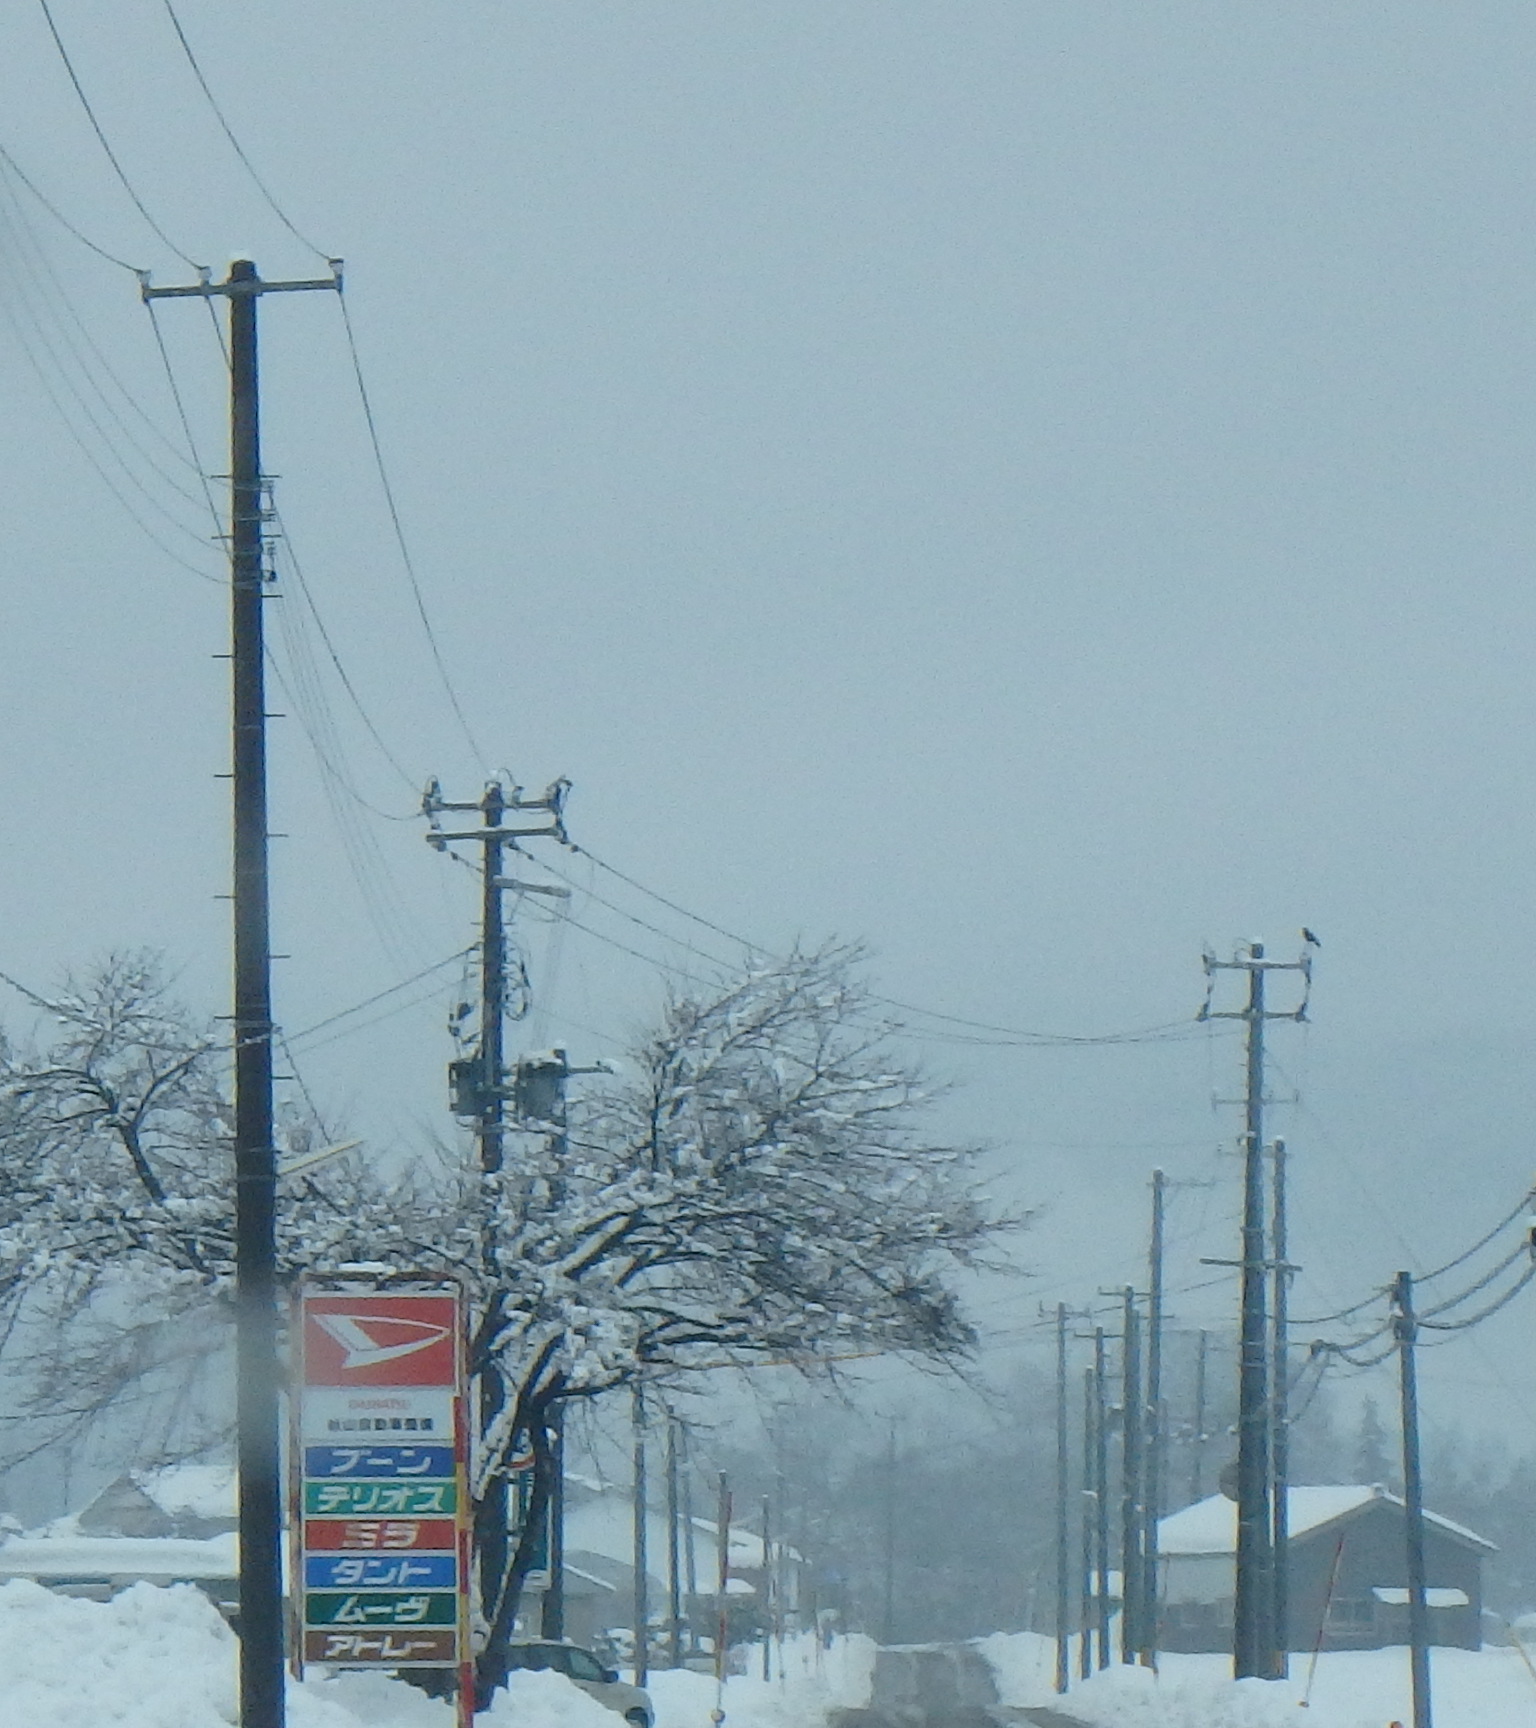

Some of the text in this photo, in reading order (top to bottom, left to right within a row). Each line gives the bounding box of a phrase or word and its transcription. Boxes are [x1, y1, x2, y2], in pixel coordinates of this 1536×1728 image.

[331, 1449, 431, 1473] ブーン
[319, 1486, 443, 1513] テリオス
[342, 1523, 420, 1548] ミラ
[331, 1560, 431, 1585] タント
[334, 1596, 430, 1622] ムーヴ
[325, 1635, 437, 1657] アトレー
